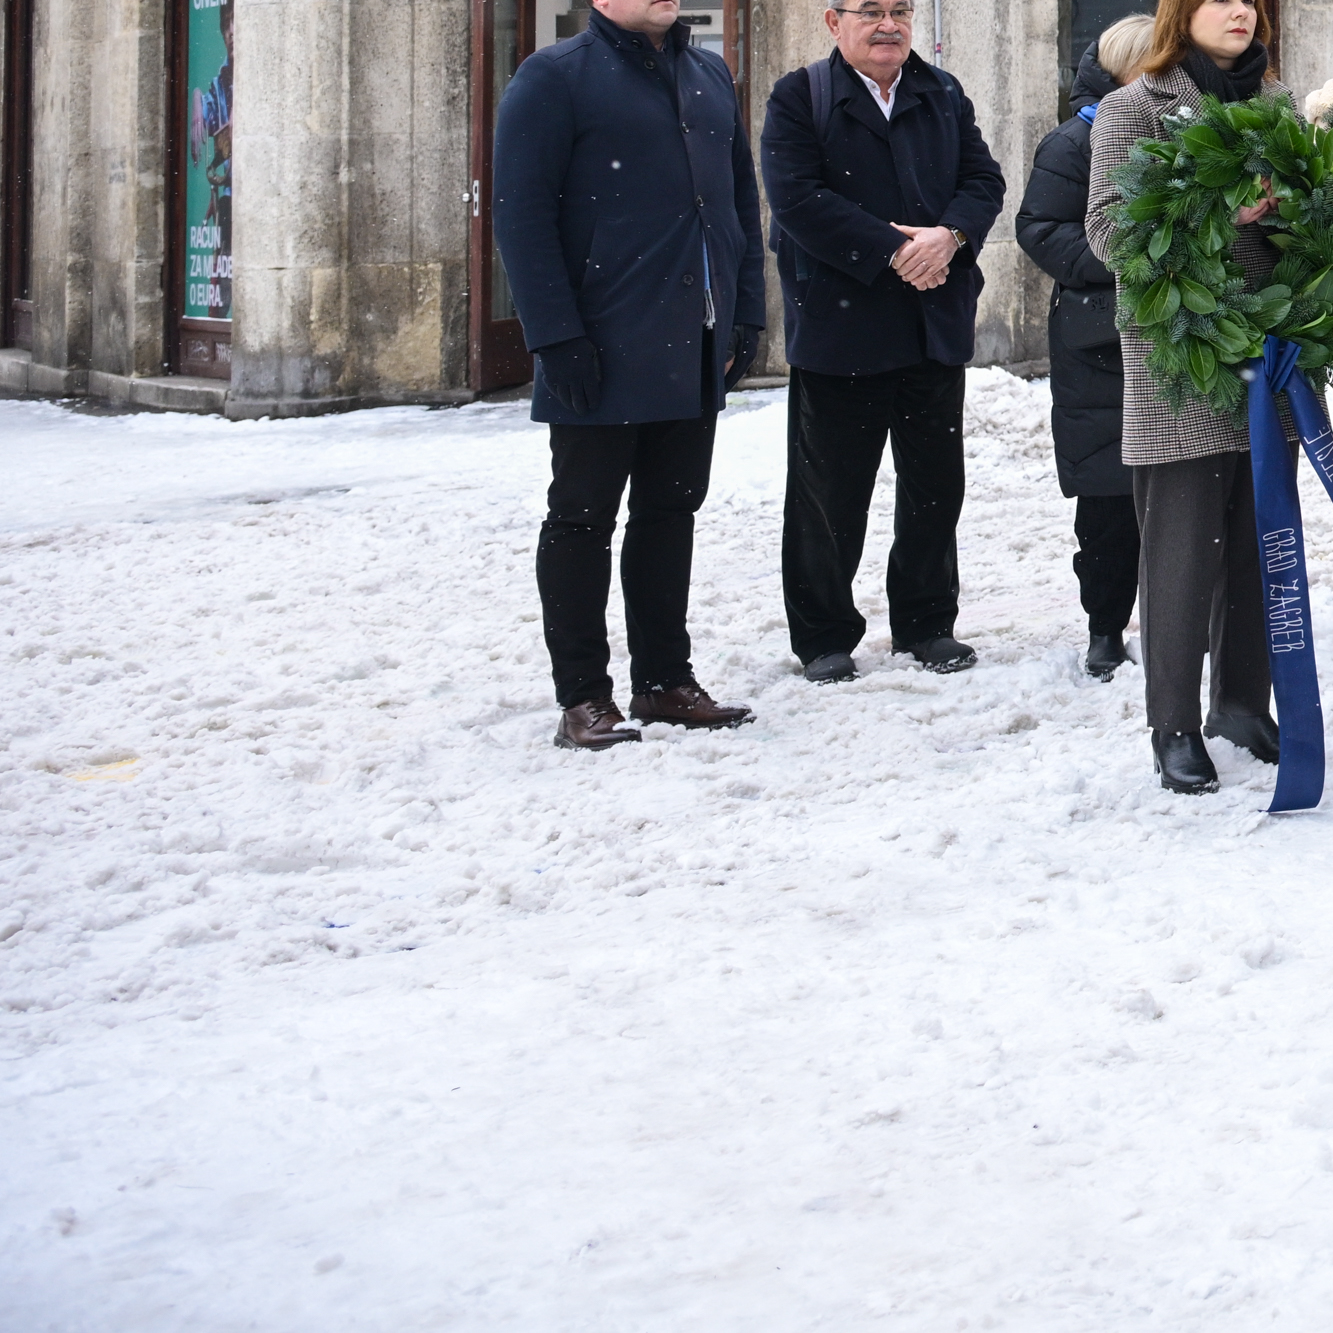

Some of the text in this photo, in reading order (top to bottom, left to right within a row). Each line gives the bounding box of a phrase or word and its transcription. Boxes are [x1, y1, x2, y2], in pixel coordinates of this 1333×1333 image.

[190, 219, 221, 249] RAČUN
[190, 255, 201, 278] ZA
[197, 284, 223, 307] EURA.
[1262, 527, 1306, 654] GRAD ZAGREB
